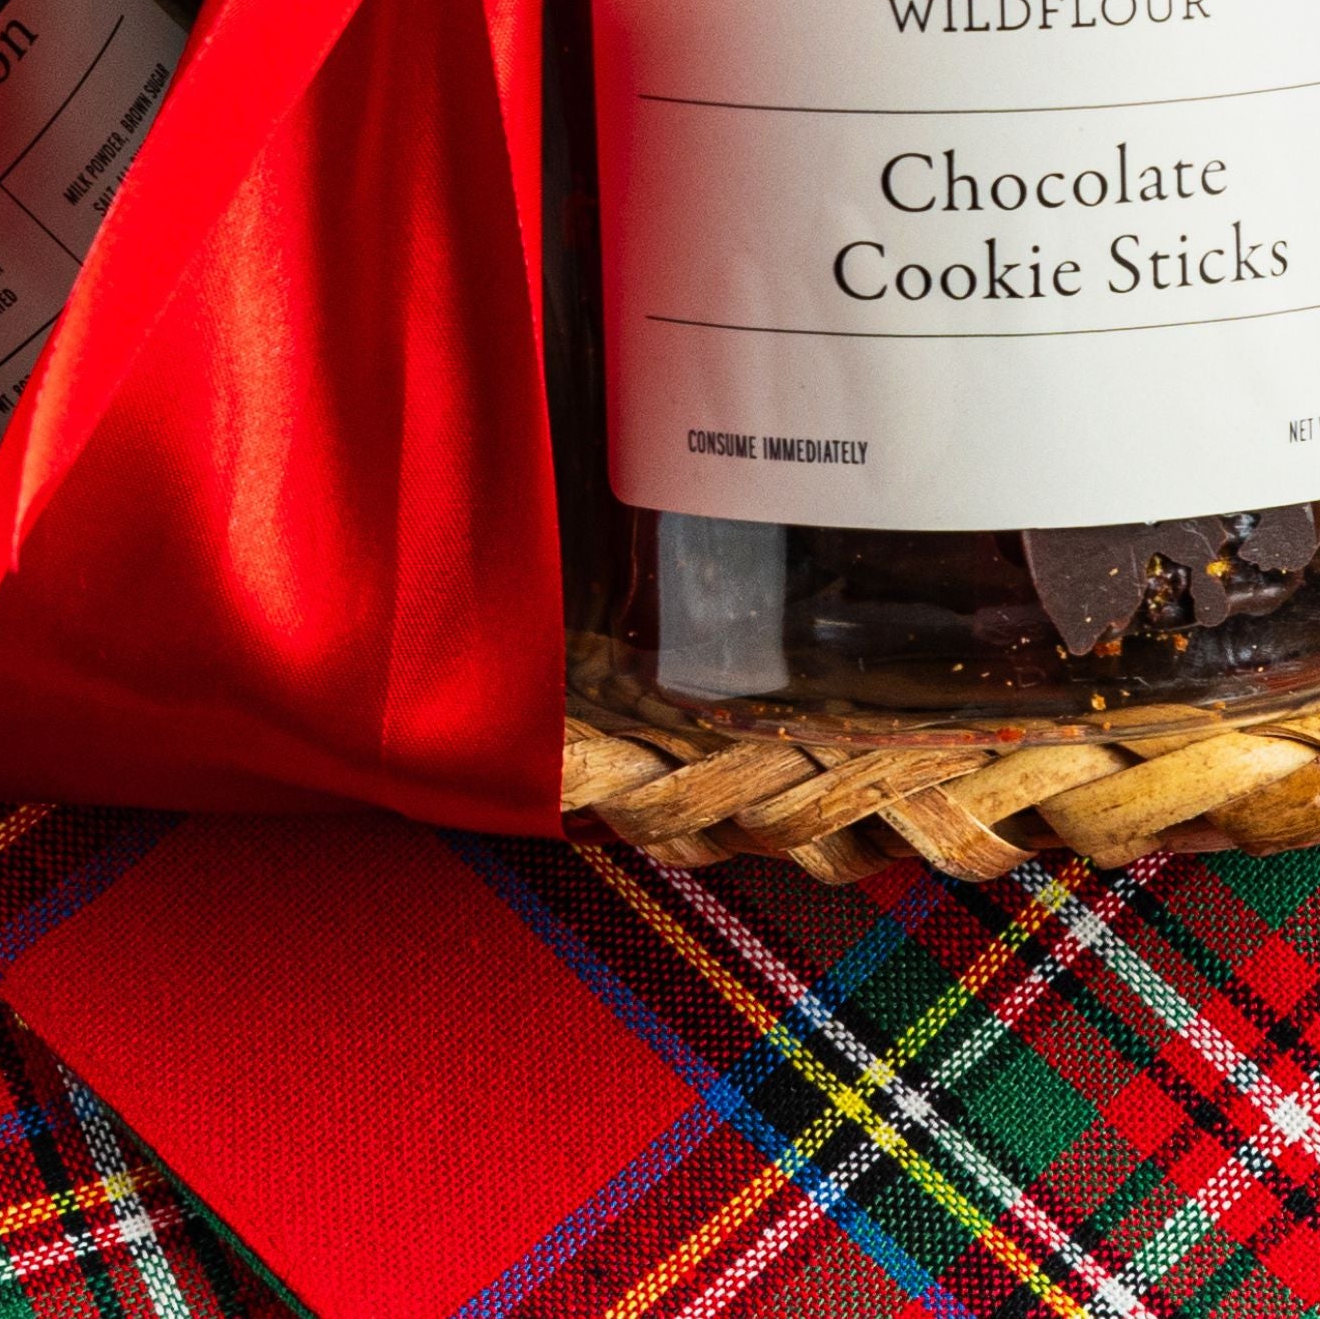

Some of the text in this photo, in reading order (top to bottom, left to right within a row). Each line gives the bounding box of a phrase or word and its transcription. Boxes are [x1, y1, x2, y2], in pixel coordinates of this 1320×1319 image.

[63, 173, 94, 206] MILK
[85, 131, 129, 179] POWDER,
[120, 92, 152, 134] BROWN
[879, 143, 1228, 214] Chocolate
[832, 222, 1290, 303] Cookie Sticks
[687, 429, 869, 465] CONSUME IMMEDIATELY
[1288, 418, 1314, 443] NET
